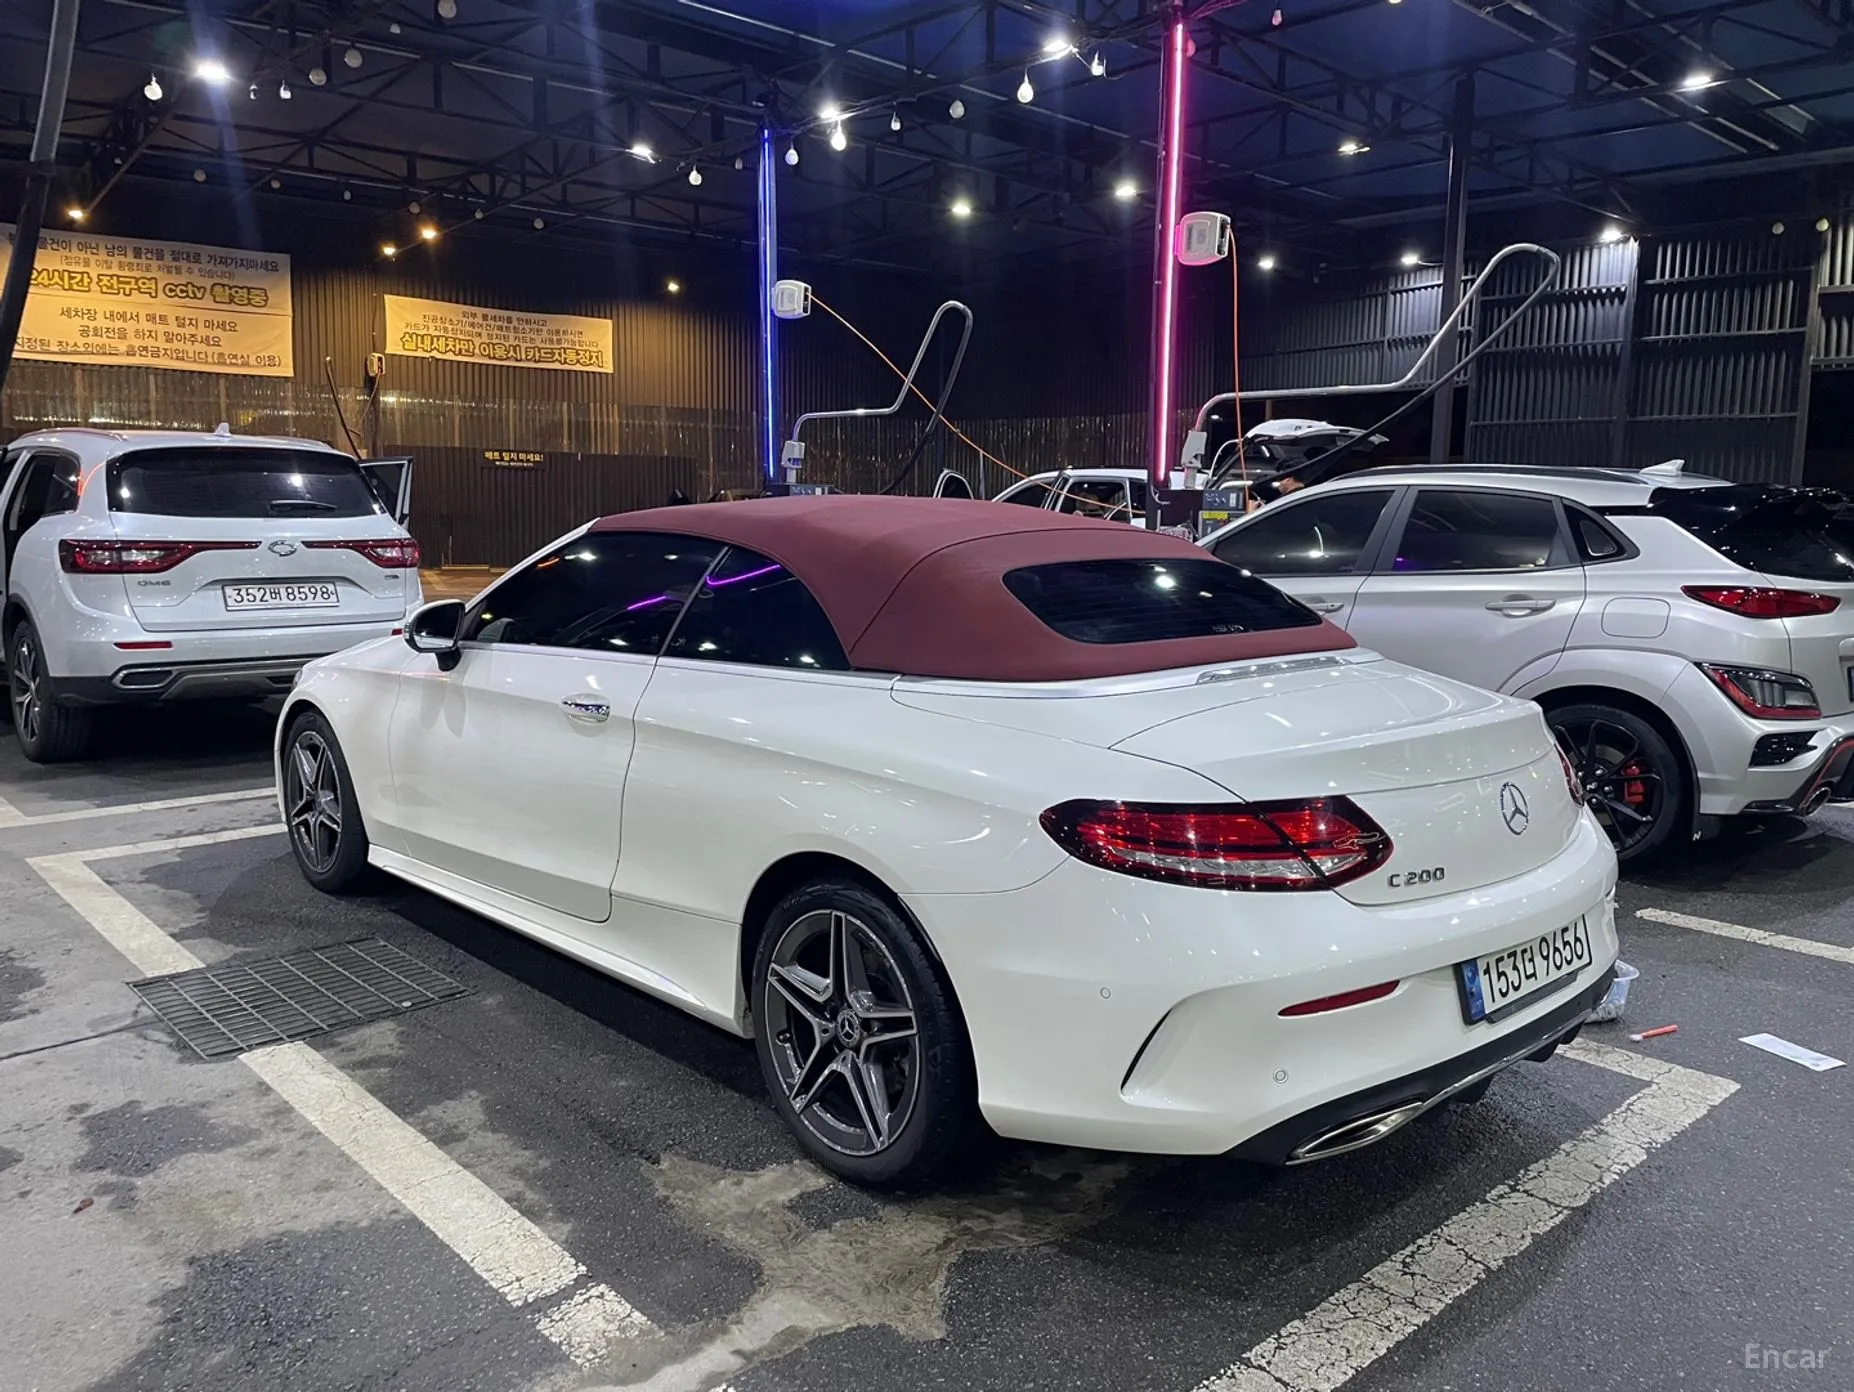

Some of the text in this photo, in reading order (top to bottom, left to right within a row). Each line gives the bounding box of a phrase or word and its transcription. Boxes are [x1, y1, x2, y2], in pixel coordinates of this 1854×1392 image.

[77, 240, 99, 255] 아닌
[105, 243, 127, 258] 남의
[132, 246, 165, 261] 물건을
[170, 249, 202, 264] 절대로
[95, 259, 113, 270] 이탈
[186, 267, 193, 276] 수
[97, 273, 158, 298] 전구역
[163, 282, 206, 301] cctv
[211, 283, 269, 307] 촬영중
[60, 307, 238, 332] 세차장 내에서 매트 털지 마세요
[78, 325, 222, 347] 공회전을 하지 말아주세요
[57, 341, 120, 355] 장소외에는
[256, 355, 282, 368] 이용)
[400, 332, 604, 368] 실내세차만 이용시 카드자동정지
[1403, 867, 1445, 887] 200
